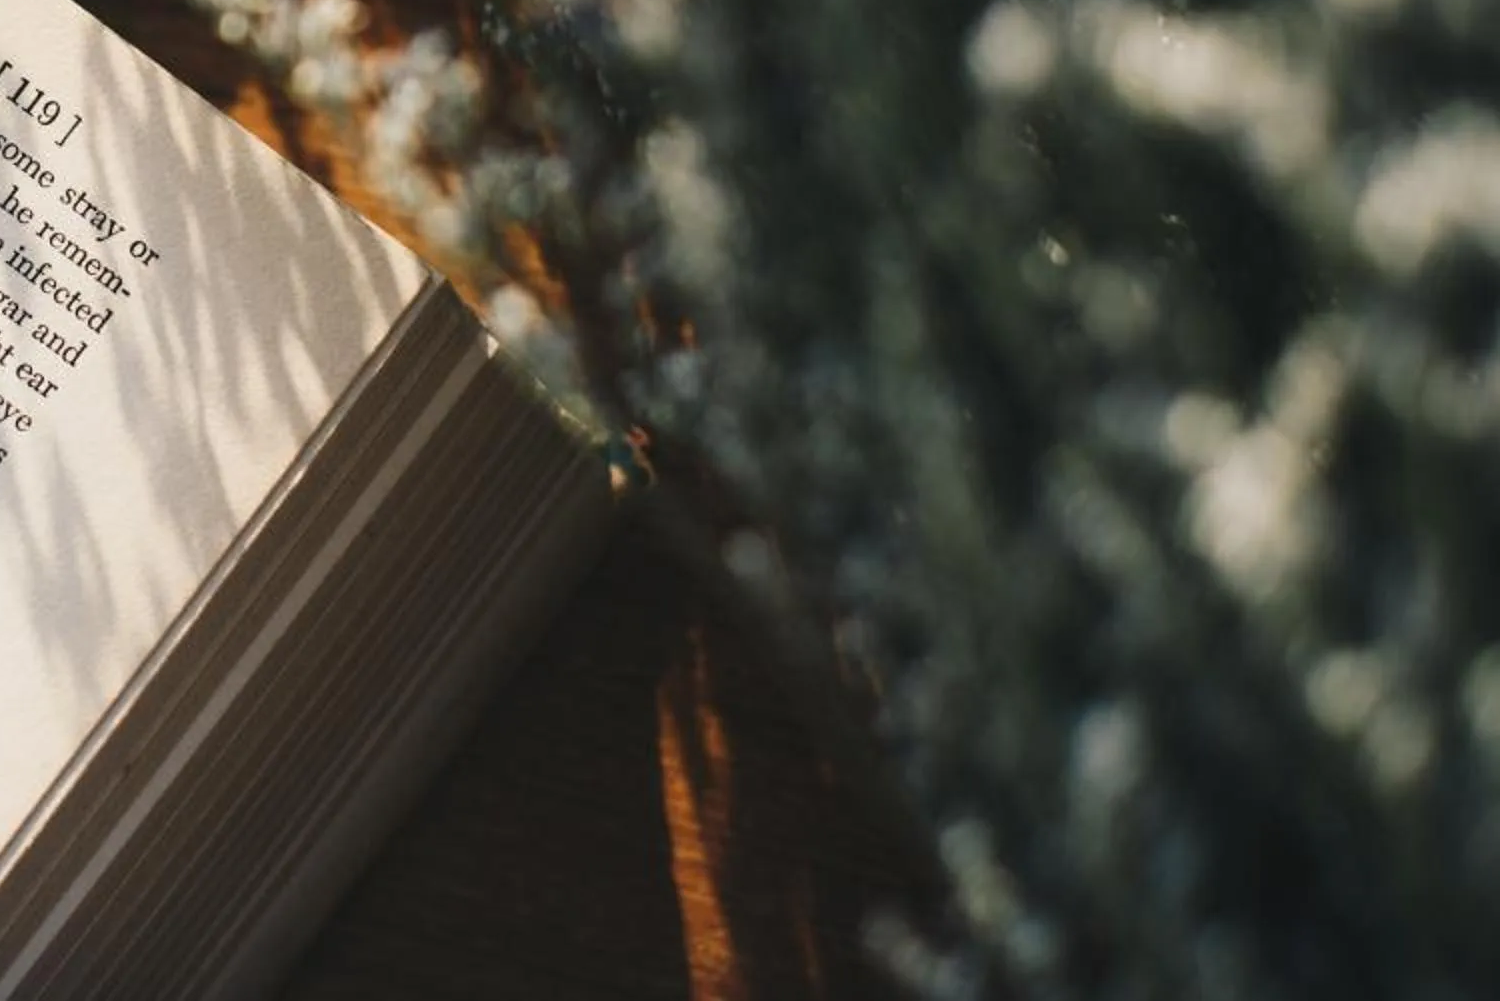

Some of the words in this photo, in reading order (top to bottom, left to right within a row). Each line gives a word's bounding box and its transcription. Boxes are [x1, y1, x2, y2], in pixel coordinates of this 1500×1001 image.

[59, 188, 125, 243] stray
[35, 221, 131, 297] remem-
[5, 245, 114, 335] infected
[31, 324, 88, 368] and
[15, 362, 59, 398] ear
